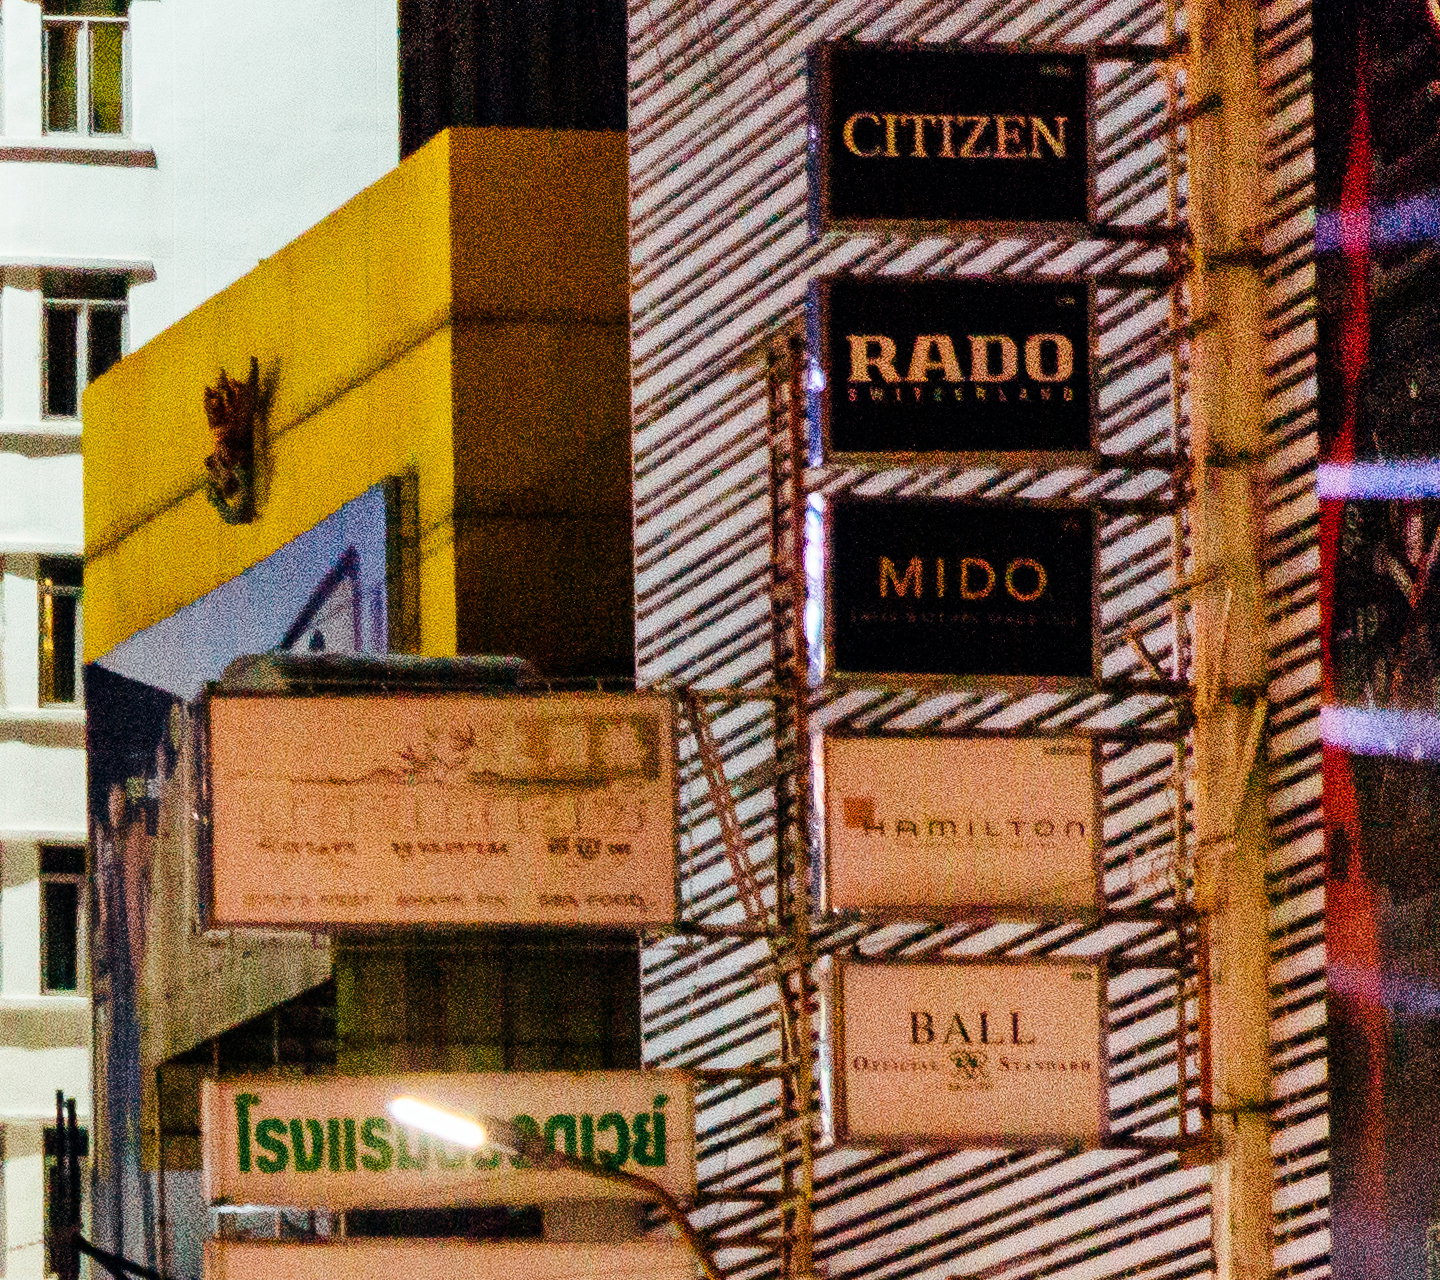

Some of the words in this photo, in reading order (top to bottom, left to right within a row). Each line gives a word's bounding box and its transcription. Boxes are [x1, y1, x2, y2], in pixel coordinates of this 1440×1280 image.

[843, 111, 1069, 160] CITIZEN
[849, 335, 1075, 384] RADO
[879, 558, 1048, 601] MIDO
[862, 820, 1086, 838] HAMILTON
[910, 1011, 1036, 1046] BALL
